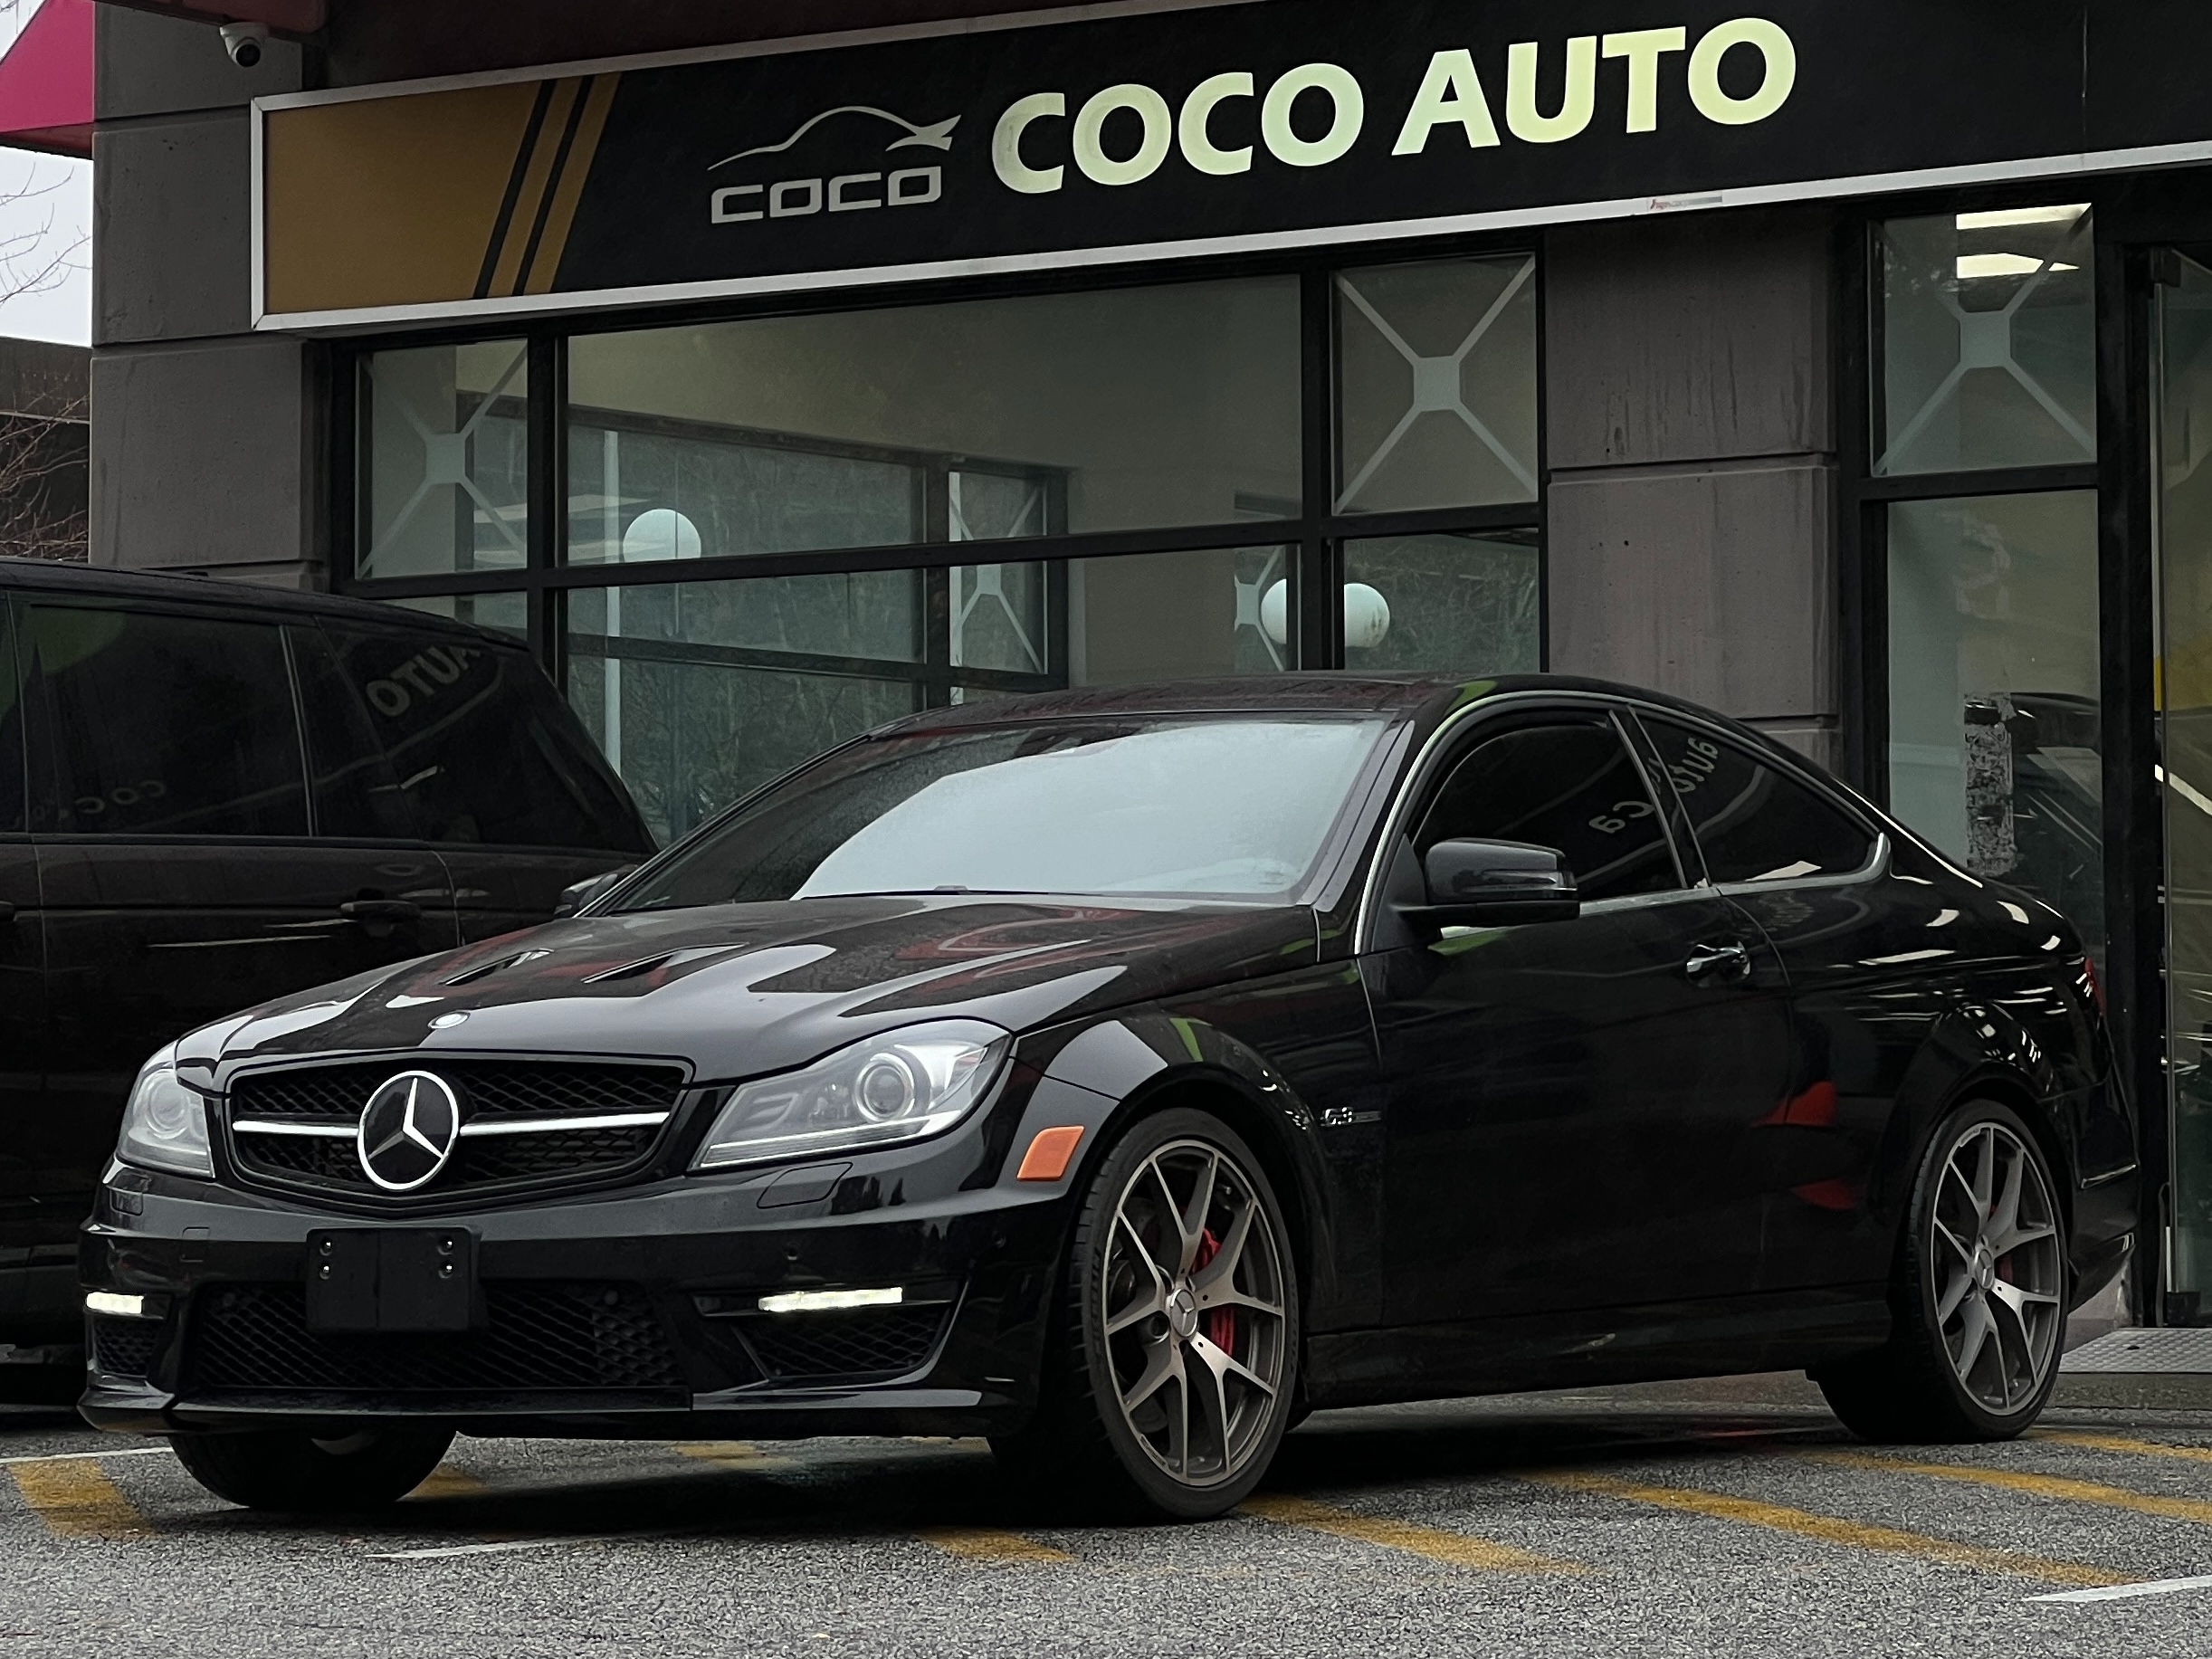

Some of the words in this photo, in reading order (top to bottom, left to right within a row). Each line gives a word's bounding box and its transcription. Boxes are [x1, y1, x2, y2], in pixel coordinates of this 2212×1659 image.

[992, 63, 1364, 194] COCO
[1391, 18, 1796, 156] AUTO
[711, 166, 941, 224] COCO
